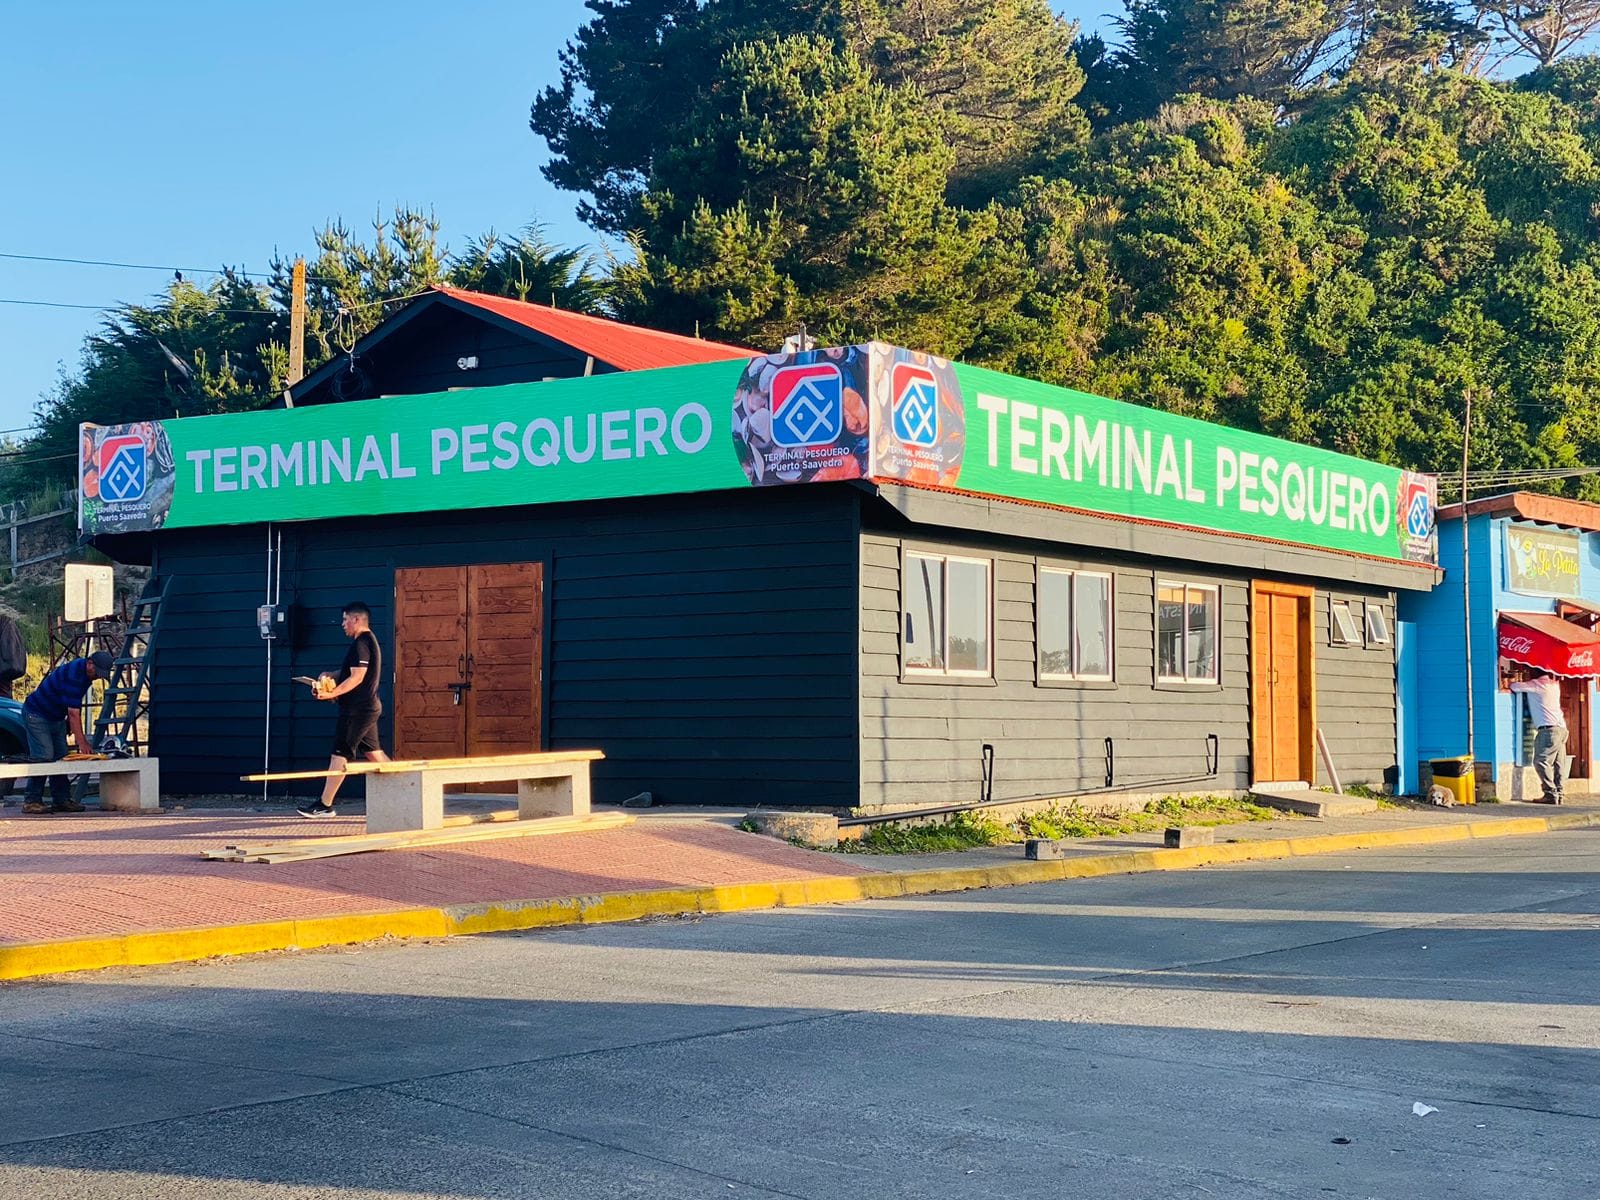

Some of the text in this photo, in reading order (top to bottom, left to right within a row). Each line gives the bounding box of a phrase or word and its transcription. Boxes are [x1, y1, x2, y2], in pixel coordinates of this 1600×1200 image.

[186, 402, 713, 494] TERMINAL PESQUERO
[764, 446, 850, 462] TERMINAL PESQUERO
[888, 445, 943, 463] TERMINAL PESQUERO
[770, 459, 843, 472] Puerto Saavedra
[892, 456, 912, 467] Puerto
[977, 393, 1390, 537] TERMINAL PESQUERO
[121, 502, 151, 511] PESQUERO
[98, 512, 147, 522] Puerto Saavedra
